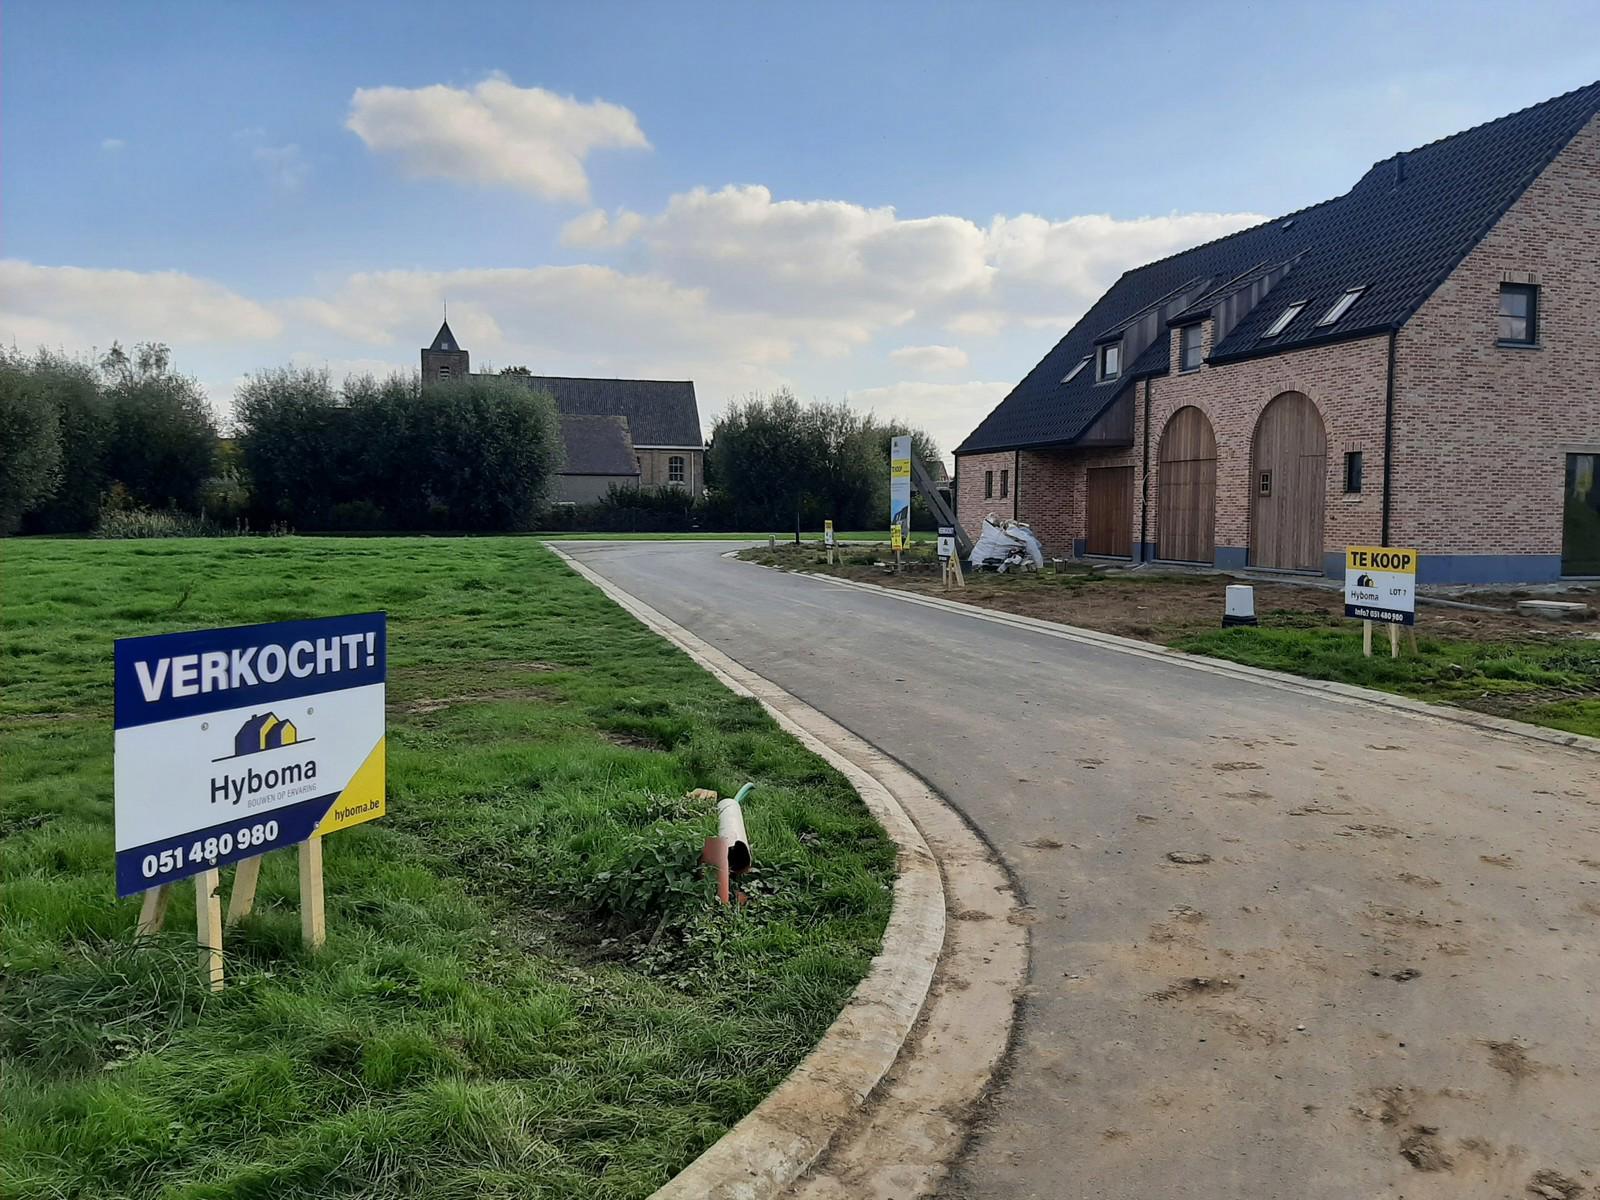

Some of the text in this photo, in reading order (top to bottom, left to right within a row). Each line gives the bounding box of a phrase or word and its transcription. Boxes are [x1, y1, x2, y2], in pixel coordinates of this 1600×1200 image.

[1351, 551, 1411, 570] TE KOOP
[1351, 590, 1379, 601] Hyboma
[1389, 588, 1402, 596] LOT
[1354, 608, 1369, 617] Info?
[1369, 610, 1380, 618] 051
[1380, 611, 1391, 620] 480
[134, 632, 376, 703] VERKOCHT!
[210, 760, 317, 806] Hyboma
[247, 783, 317, 809] BOUWEN OP ERVARING
[334, 799, 380, 822] hyboma.be
[142, 820, 279, 878] 051 480 980
